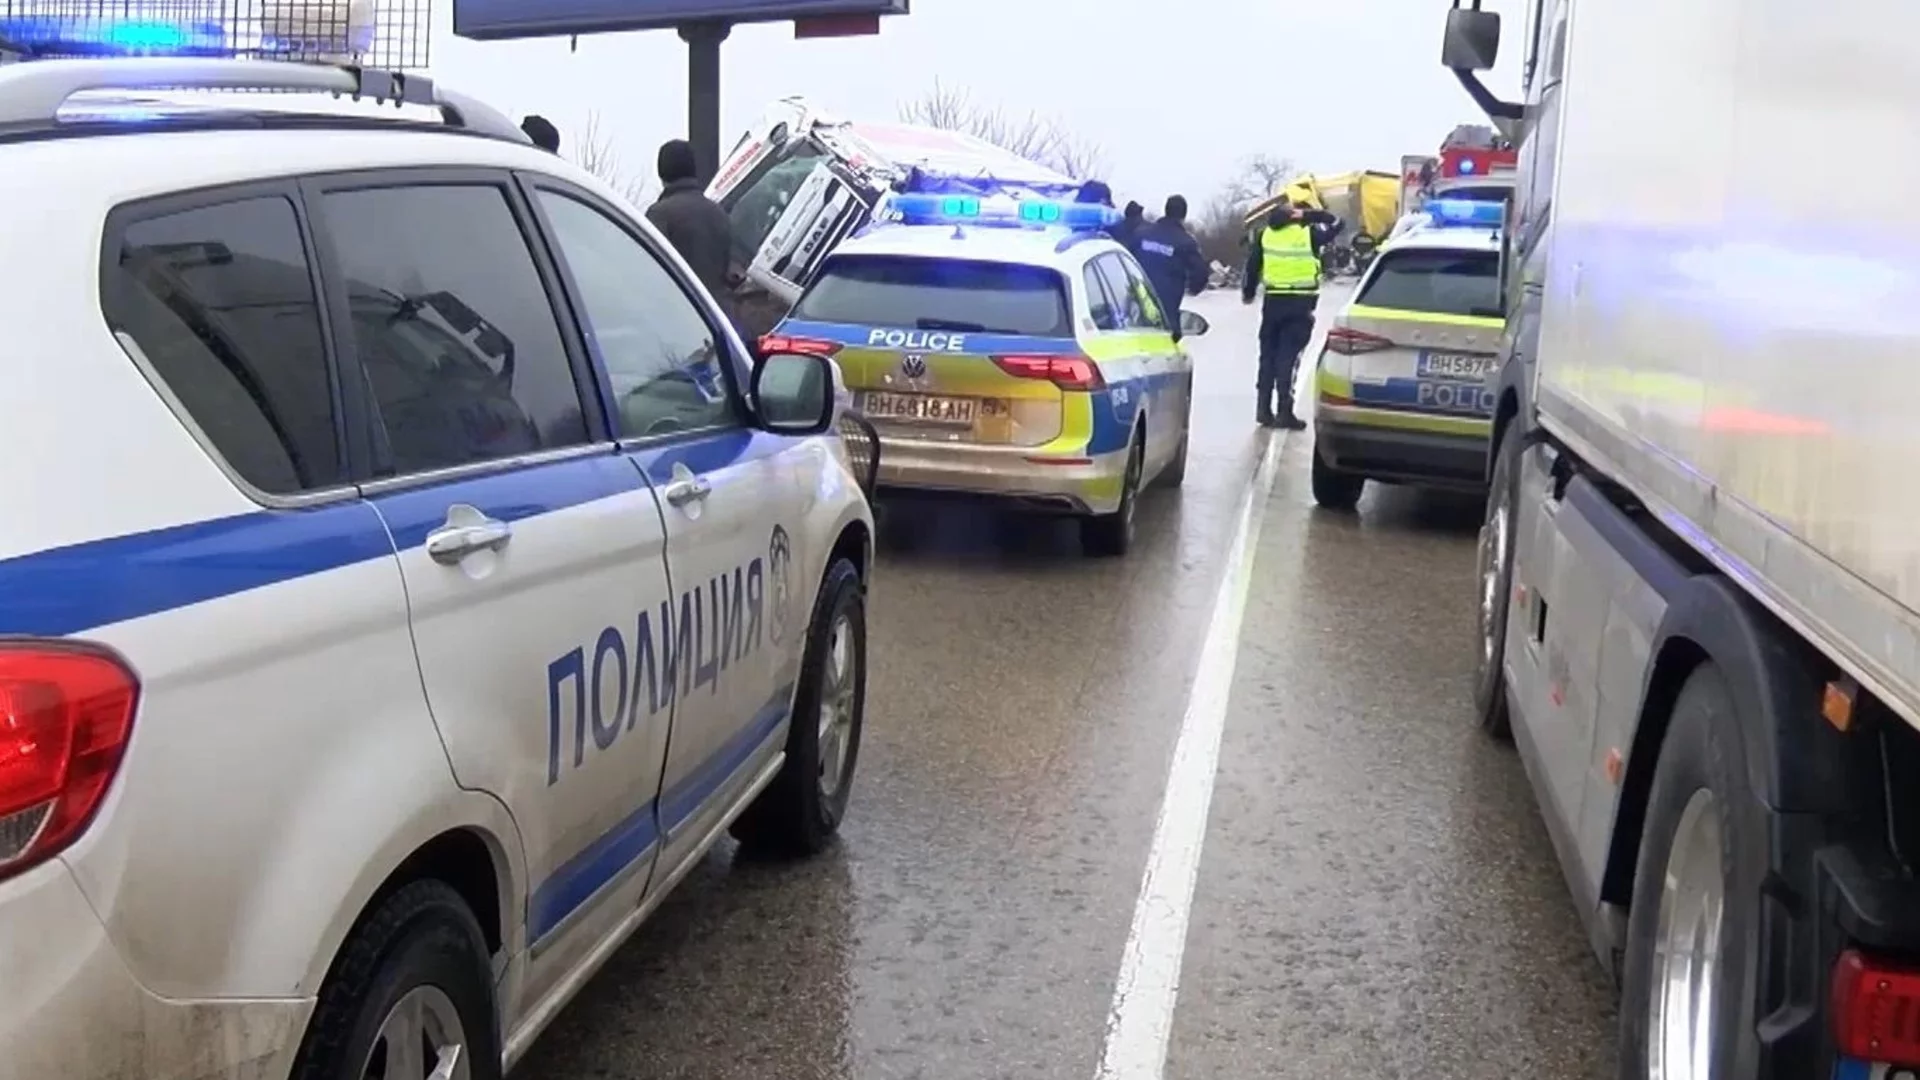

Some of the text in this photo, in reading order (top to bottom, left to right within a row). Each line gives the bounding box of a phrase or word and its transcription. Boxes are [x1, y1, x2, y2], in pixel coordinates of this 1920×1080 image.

[868, 328, 966, 351] POLICE
[1417, 382, 1495, 410] POLIC
[547, 556, 763, 788] ПОЛИЦИЯ
